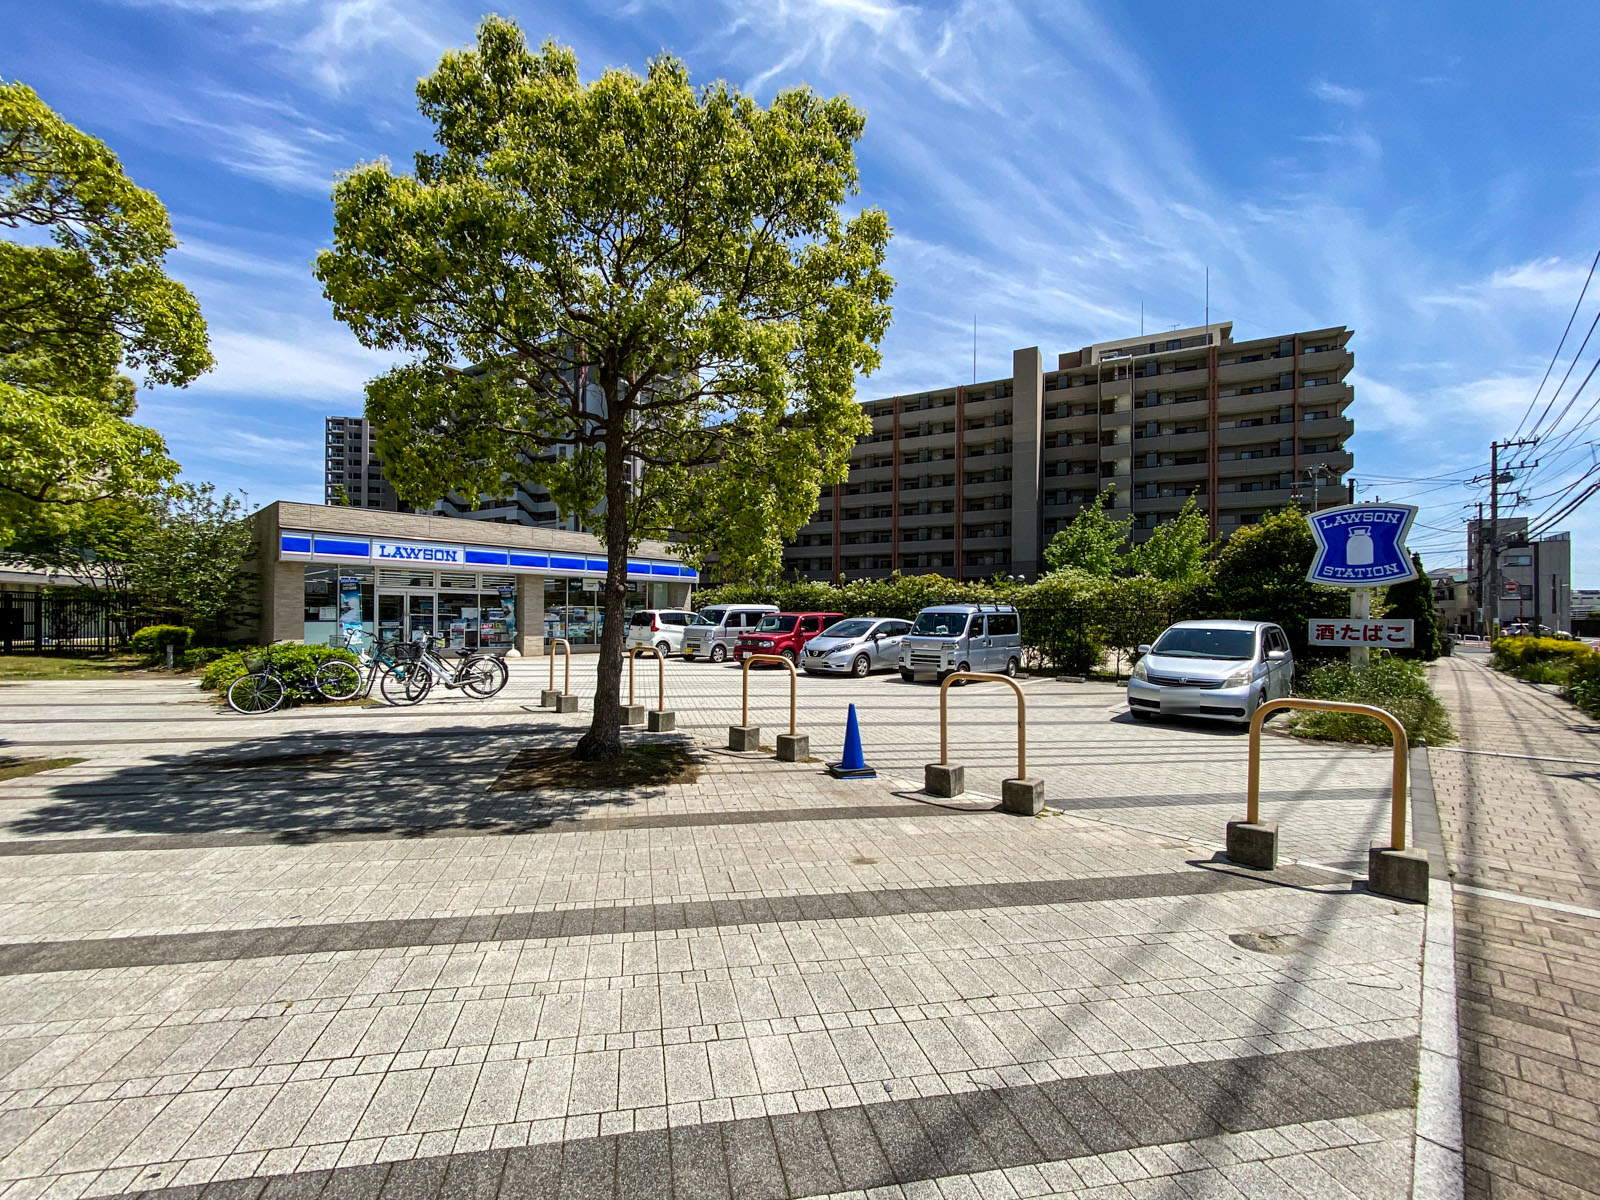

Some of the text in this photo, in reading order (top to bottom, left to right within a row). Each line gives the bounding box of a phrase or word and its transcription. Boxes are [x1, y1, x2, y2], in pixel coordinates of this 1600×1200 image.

[1321, 512, 1400, 529] LAWSON
[379, 545, 457, 562] LAWSON
[1322, 563, 1400, 578] STATION
